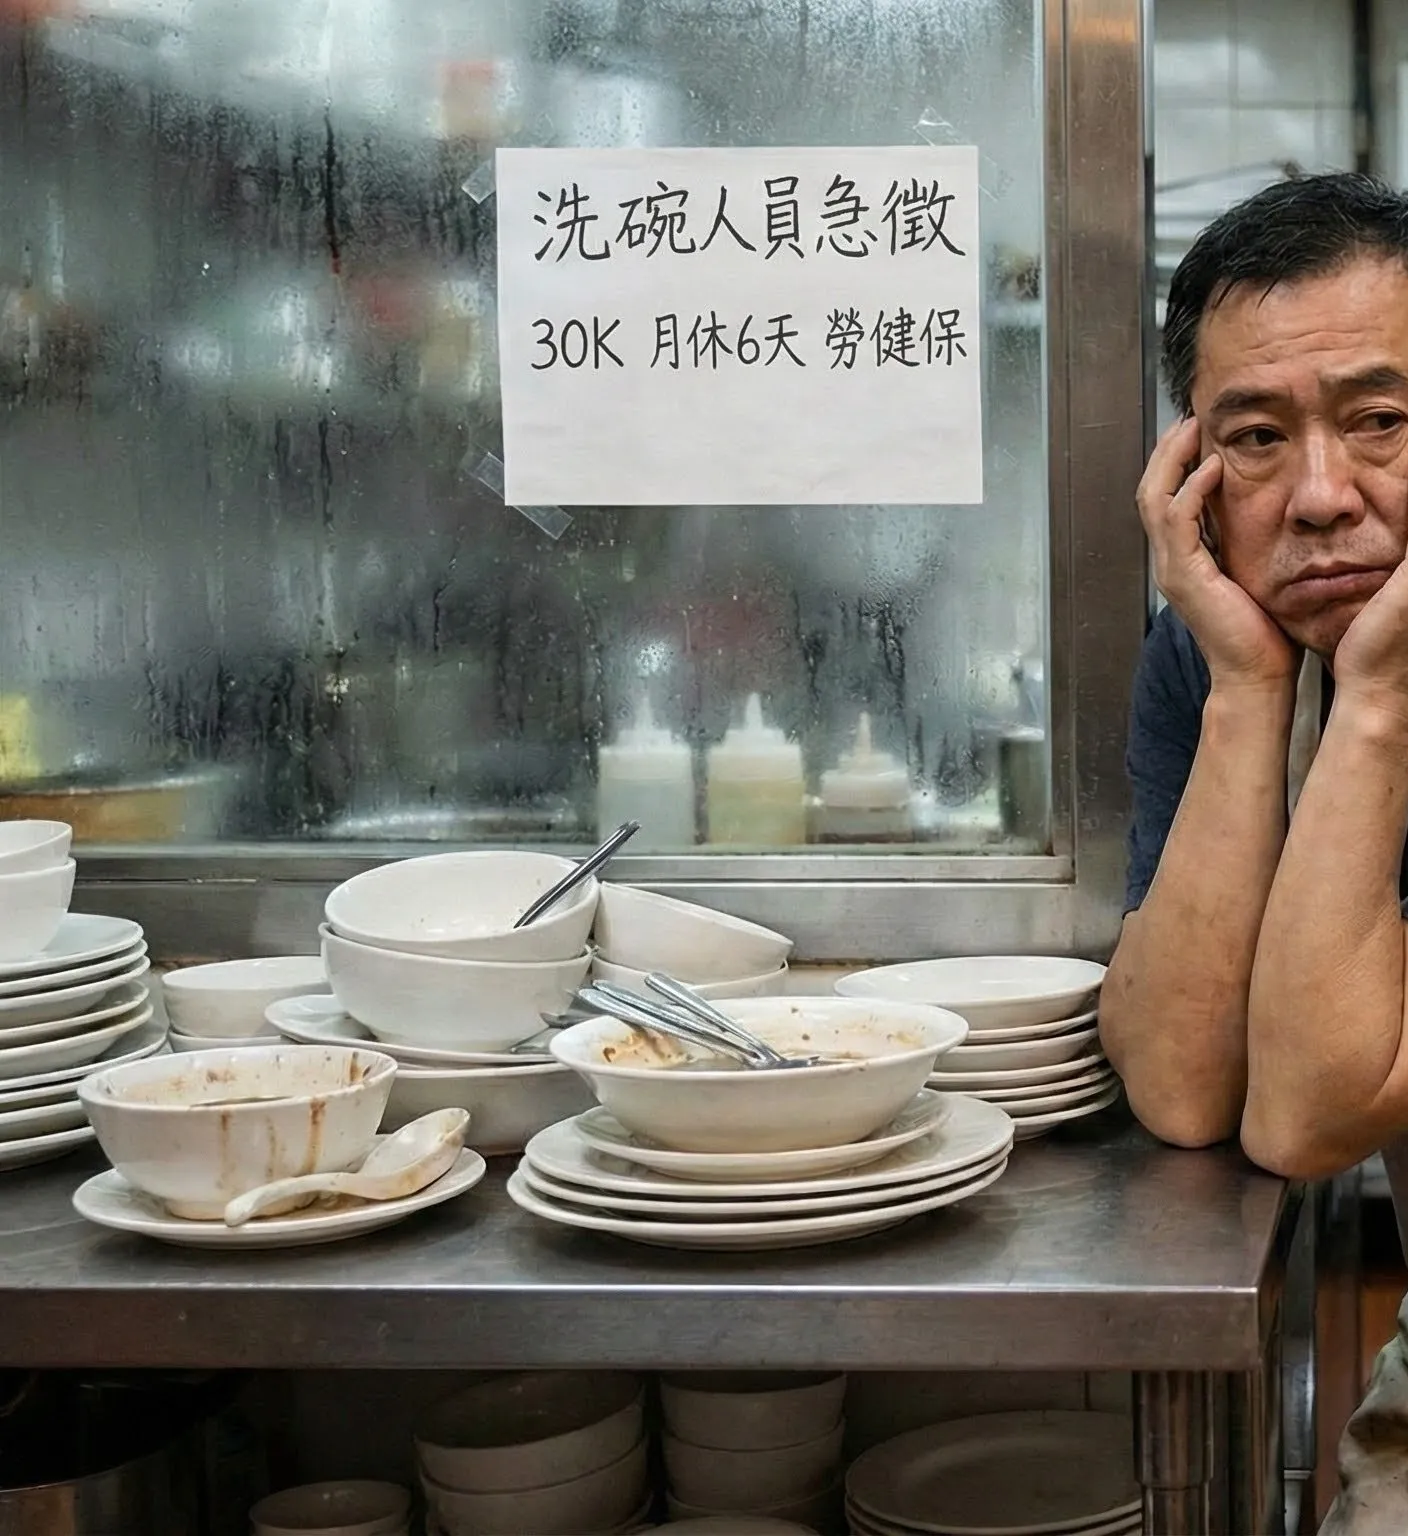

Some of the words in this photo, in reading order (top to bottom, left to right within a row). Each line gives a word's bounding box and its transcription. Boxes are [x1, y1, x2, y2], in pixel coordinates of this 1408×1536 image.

[532, 174, 967, 263] 洗碗人員急徵
[530, 315, 625, 371] 30K
[649, 310, 807, 371] 月休6天
[824, 306, 968, 371] 勞健保
